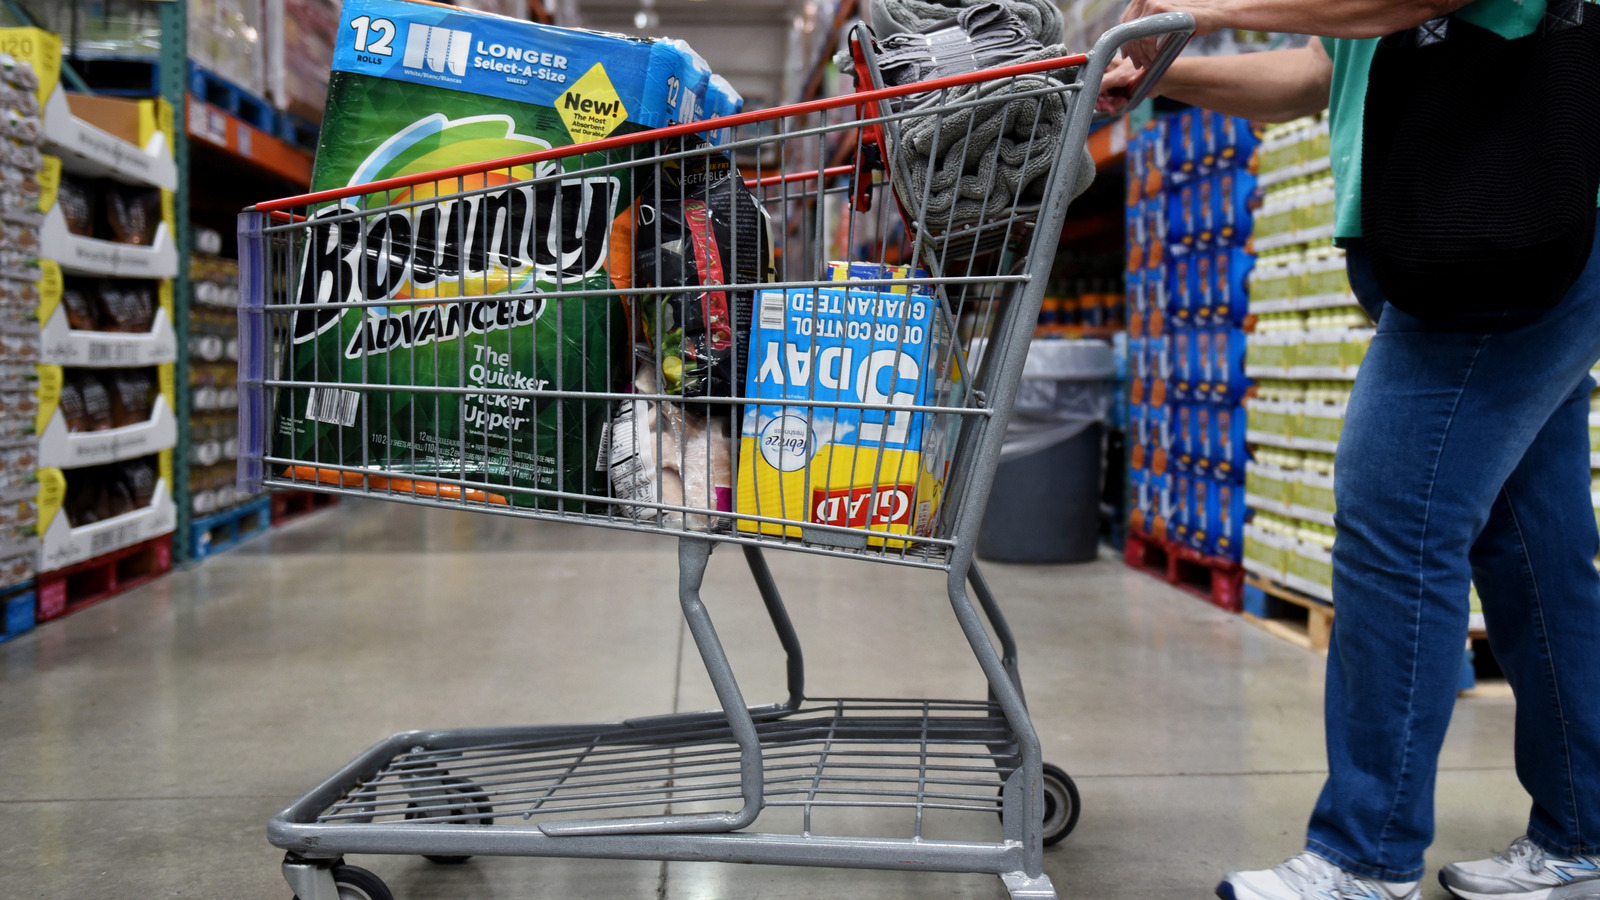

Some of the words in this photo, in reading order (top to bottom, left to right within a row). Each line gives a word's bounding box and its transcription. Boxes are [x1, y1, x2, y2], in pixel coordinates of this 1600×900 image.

[350, 15, 396, 56] 12
[357, 55, 382, 64] ROLLS
[476, 41, 568, 69] LONGER
[404, 70, 462, 84] White/Blanc/Blancas
[474, 57, 566, 83] Select-A-Size
[564, 92, 620, 118] New!
[667, 75, 680, 109] 12
[572, 121, 605, 131] Absorbent
[574, 113, 587, 121] The
[588, 114, 606, 124] Most
[677, 170, 724, 186] VEGETABLE
[791, 293, 925, 321] GUARANTEED
[345, 288, 546, 359] ADVANCED
[792, 316, 871, 340] CONTROL
[474, 345, 509, 366] The
[754, 341, 853, 390] DAY
[469, 364, 549, 391] Quicker
[465, 384, 530, 411] Picker
[856, 350, 920, 444] 5
[372, 433, 382, 444] 110
[419, 432, 426, 441] 12
[765, 434, 807, 457] febreze
